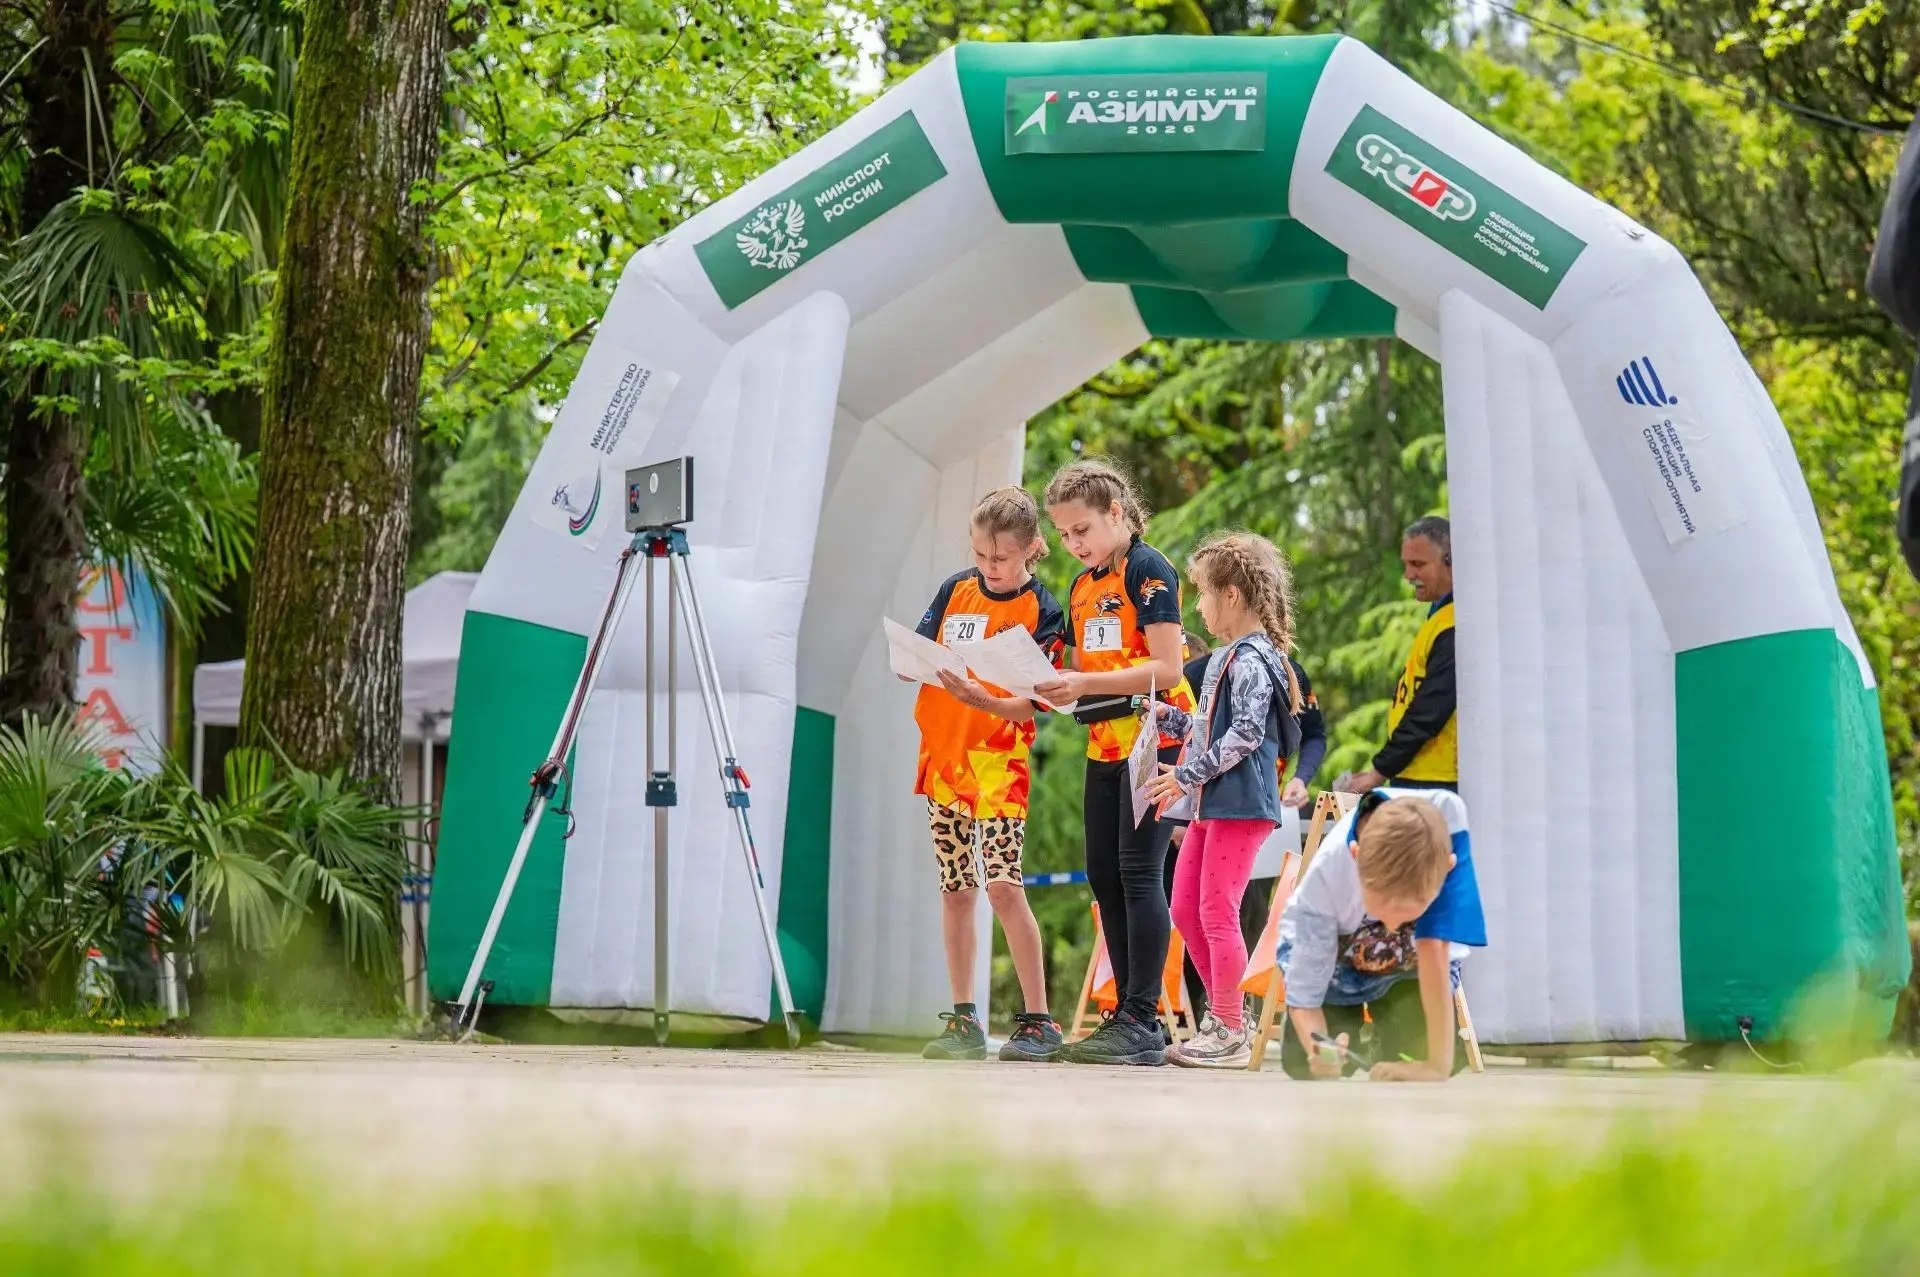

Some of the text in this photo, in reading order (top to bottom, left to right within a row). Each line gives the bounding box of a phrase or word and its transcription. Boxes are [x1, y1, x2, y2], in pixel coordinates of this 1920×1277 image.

[1066, 99, 1256, 123] АЗИМУТ
[1067, 86, 1258, 99] РОССИЙСКИЙ
[1126, 124, 1196, 134] 2026
[814, 152, 891, 207] МИНСПОРТ
[822, 179, 884, 223] РОССИИ
[1473, 232, 1507, 257] РОССИИ
[1483, 217, 1540, 257] СПОРТИВНОГО
[1488, 210, 1536, 243] ФЕДЕРАЦИЯ
[1478, 225, 1550, 274] ОРИЕНТИРОВАНИЯ
[590, 363, 637, 449] МИНИСТЕРСТВО
[606, 370, 651, 455] КРАСНОДАРСКОГО КРАЯ
[1652, 424, 1682, 478] ДИРЕКЦИЯ
[1664, 419, 1702, 493] ФЕДЕРАЛЬНАЯ
[1642, 428, 1696, 534] СПОРТМЕРОПРИЯТИЙ
[957, 621, 976, 639] 20
[1098, 626, 1105, 645] 9
